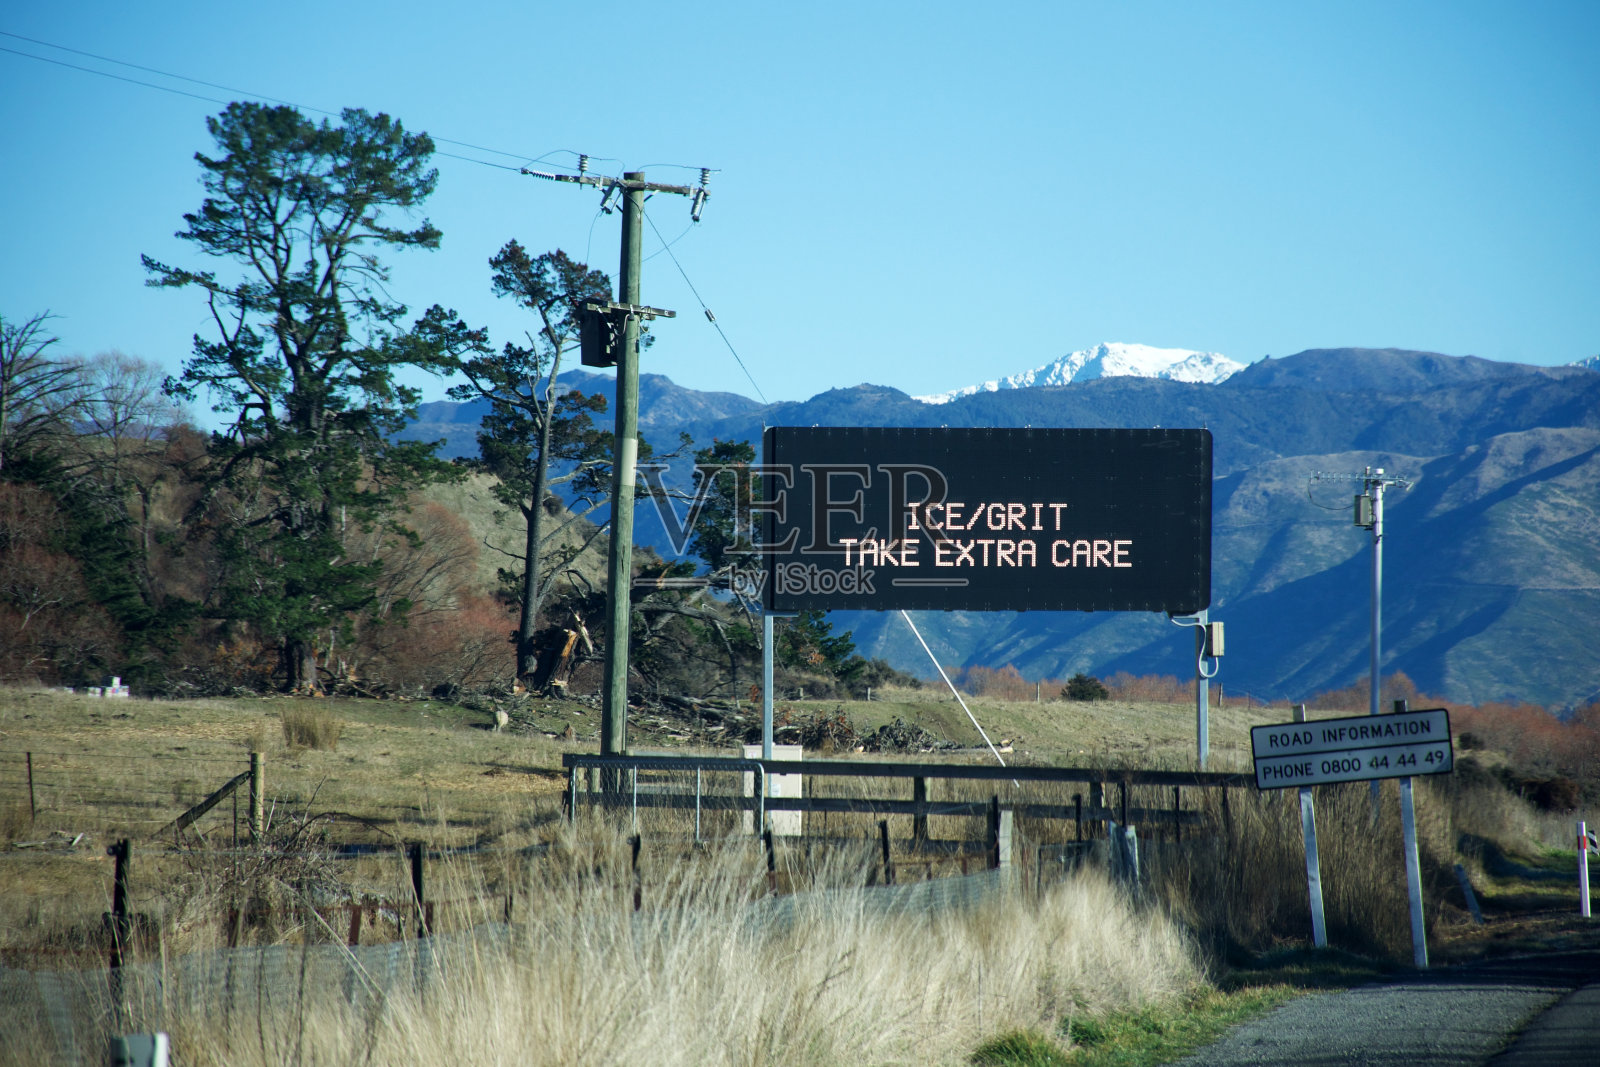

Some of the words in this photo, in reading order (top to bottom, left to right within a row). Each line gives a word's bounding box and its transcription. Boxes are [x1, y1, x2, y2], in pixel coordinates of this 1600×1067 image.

[908, 502, 1068, 531] ICE/GRIT
[839, 538, 920, 568] TAKE
[935, 539, 1037, 568] EXTRA
[1051, 539, 1133, 568] CARE
[1269, 731, 1313, 748] ROAD
[1322, 720, 1431, 743] INFORMATION
[1263, 762, 1314, 780] PHONE
[1321, 758, 1361, 775] 0800
[1369, 755, 1389, 770] 44
[1396, 753, 1417, 767] 44
[1424, 750, 1444, 764] 49
